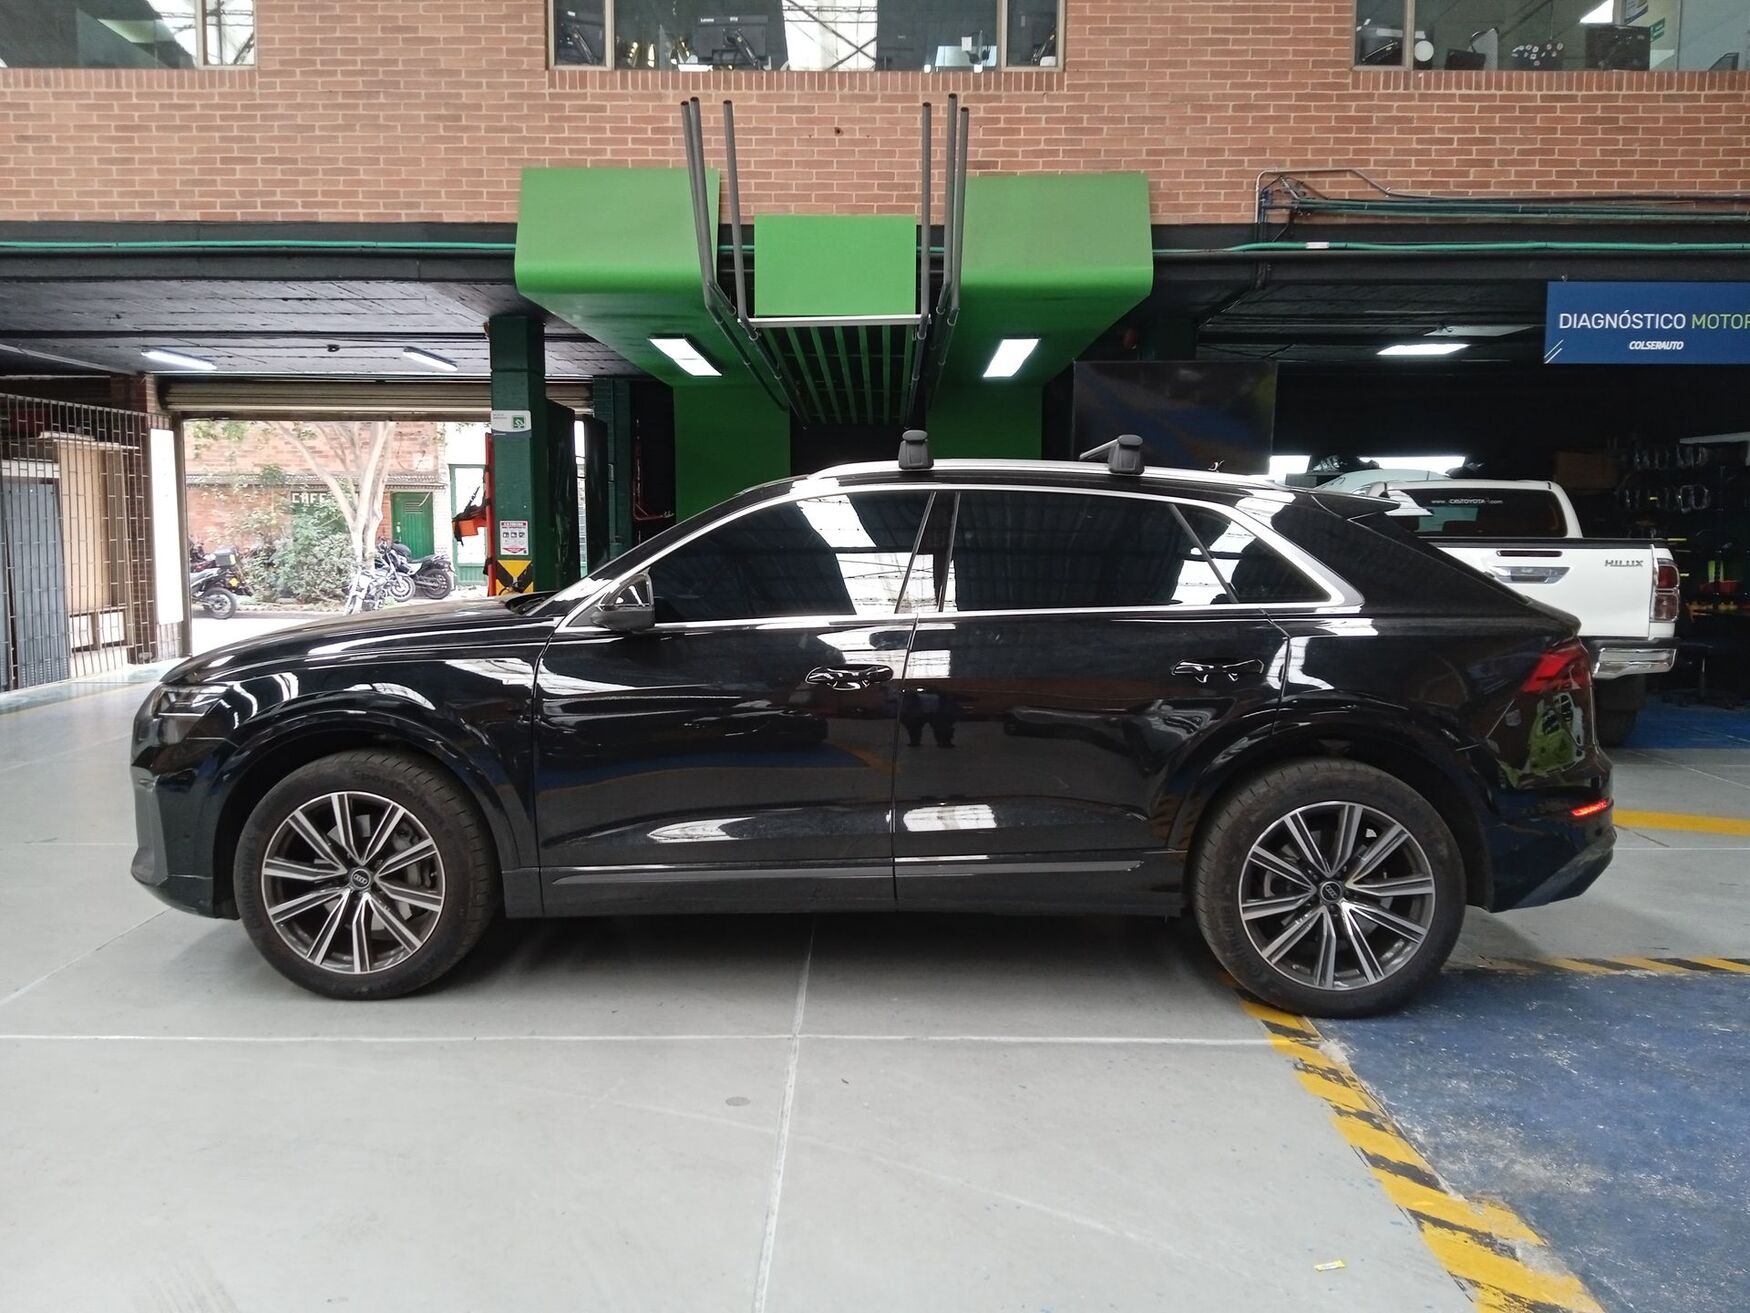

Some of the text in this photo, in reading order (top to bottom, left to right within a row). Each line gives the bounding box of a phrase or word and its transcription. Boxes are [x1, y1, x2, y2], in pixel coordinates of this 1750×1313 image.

[1558, 310, 1686, 329] DIAGNÓSTICO
[1628, 340, 1684, 351] COLSERAUTO
[1605, 559, 1644, 567] HILUX
